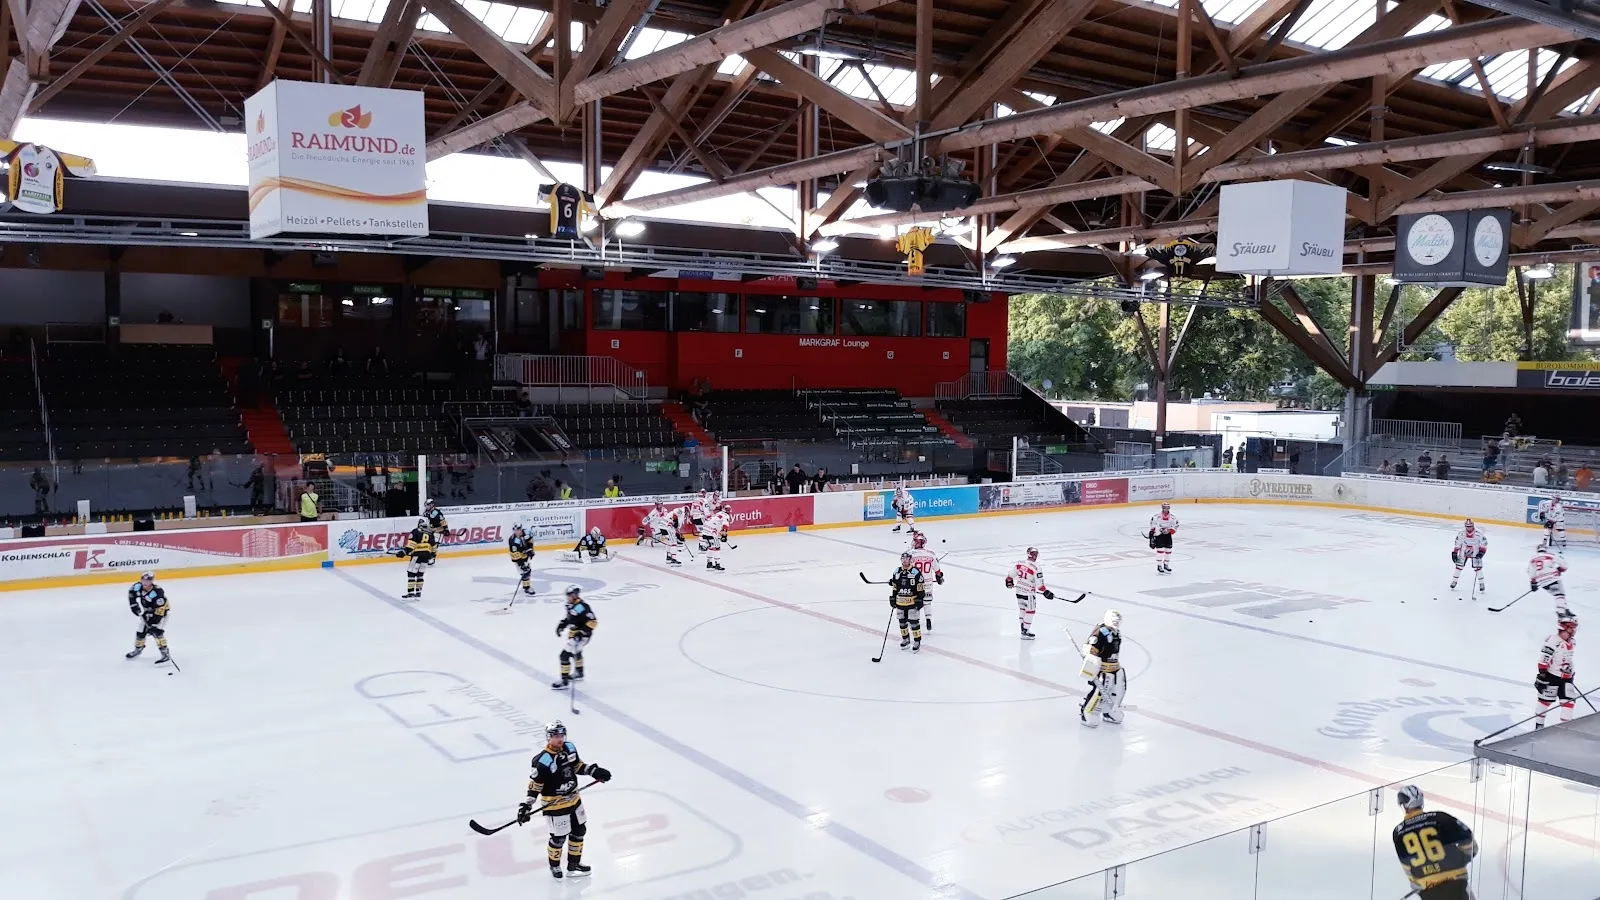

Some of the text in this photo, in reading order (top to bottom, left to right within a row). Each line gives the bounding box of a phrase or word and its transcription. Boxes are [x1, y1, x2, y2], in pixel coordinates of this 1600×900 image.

[291, 132, 415, 155] RAIMUND.de
[306, 154, 350, 163] freundliche
[352, 156, 380, 165] Energie
[564, 203, 572, 218] 6
[286, 215, 424, 229] Heizöl Pellets Tankstellen
[1230, 242, 1276, 257] STÄUBLI
[1300, 242, 1334, 257] STÄUBLI
[799, 338, 870, 349] MARKGRAF Lounge
[1250, 478, 1312, 497] BAYREUTHER
[929, 498, 955, 508] Leben.
[729, 511, 762, 525] yreuth
[357, 532, 411, 551] HERT
[1, 551, 71, 562] KOLBENSCHLAG
[108, 558, 160, 568] GERÜSTBAU
[1049, 790, 1261, 850] DACIA
[1402, 826, 1446, 868] 96
